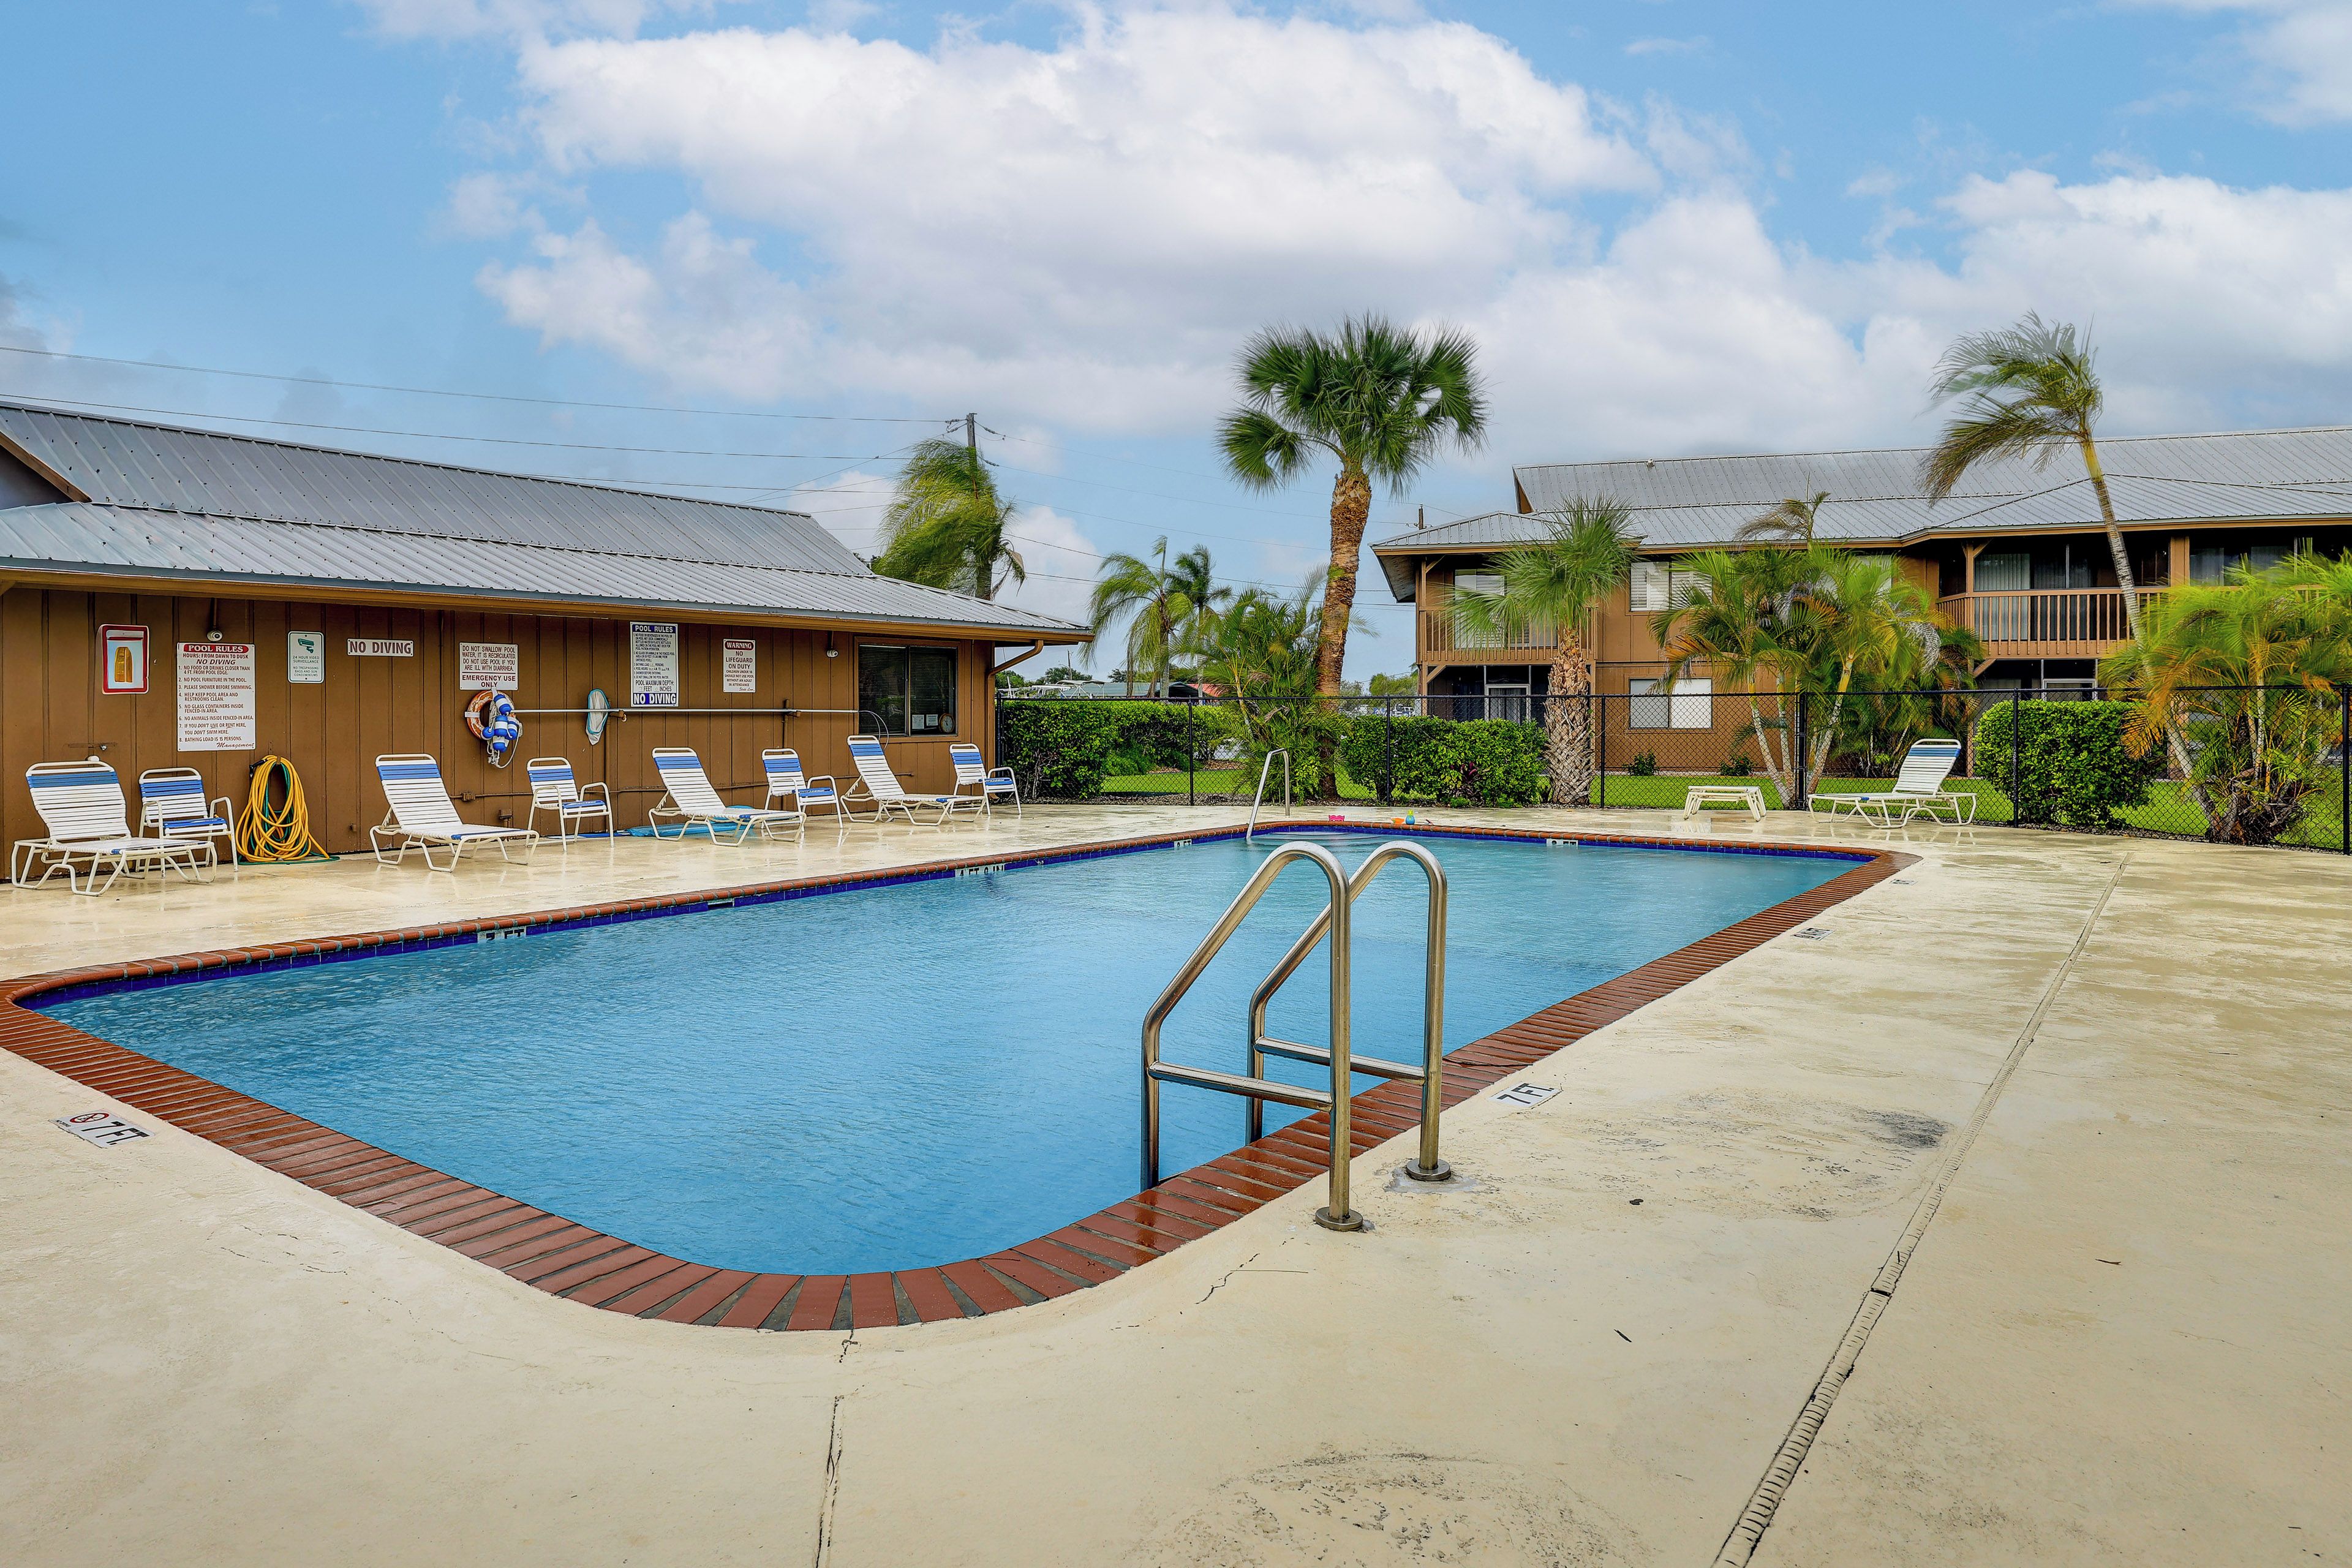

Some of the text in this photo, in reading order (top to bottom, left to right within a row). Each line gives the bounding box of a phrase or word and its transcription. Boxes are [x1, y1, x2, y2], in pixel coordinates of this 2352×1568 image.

[350, 641, 411, 654] NO DIVING
[634, 694, 676, 704] NO DIVING
[1497, 1094, 1531, 1104] 7
[81, 1121, 150, 1145] 7 FT.
